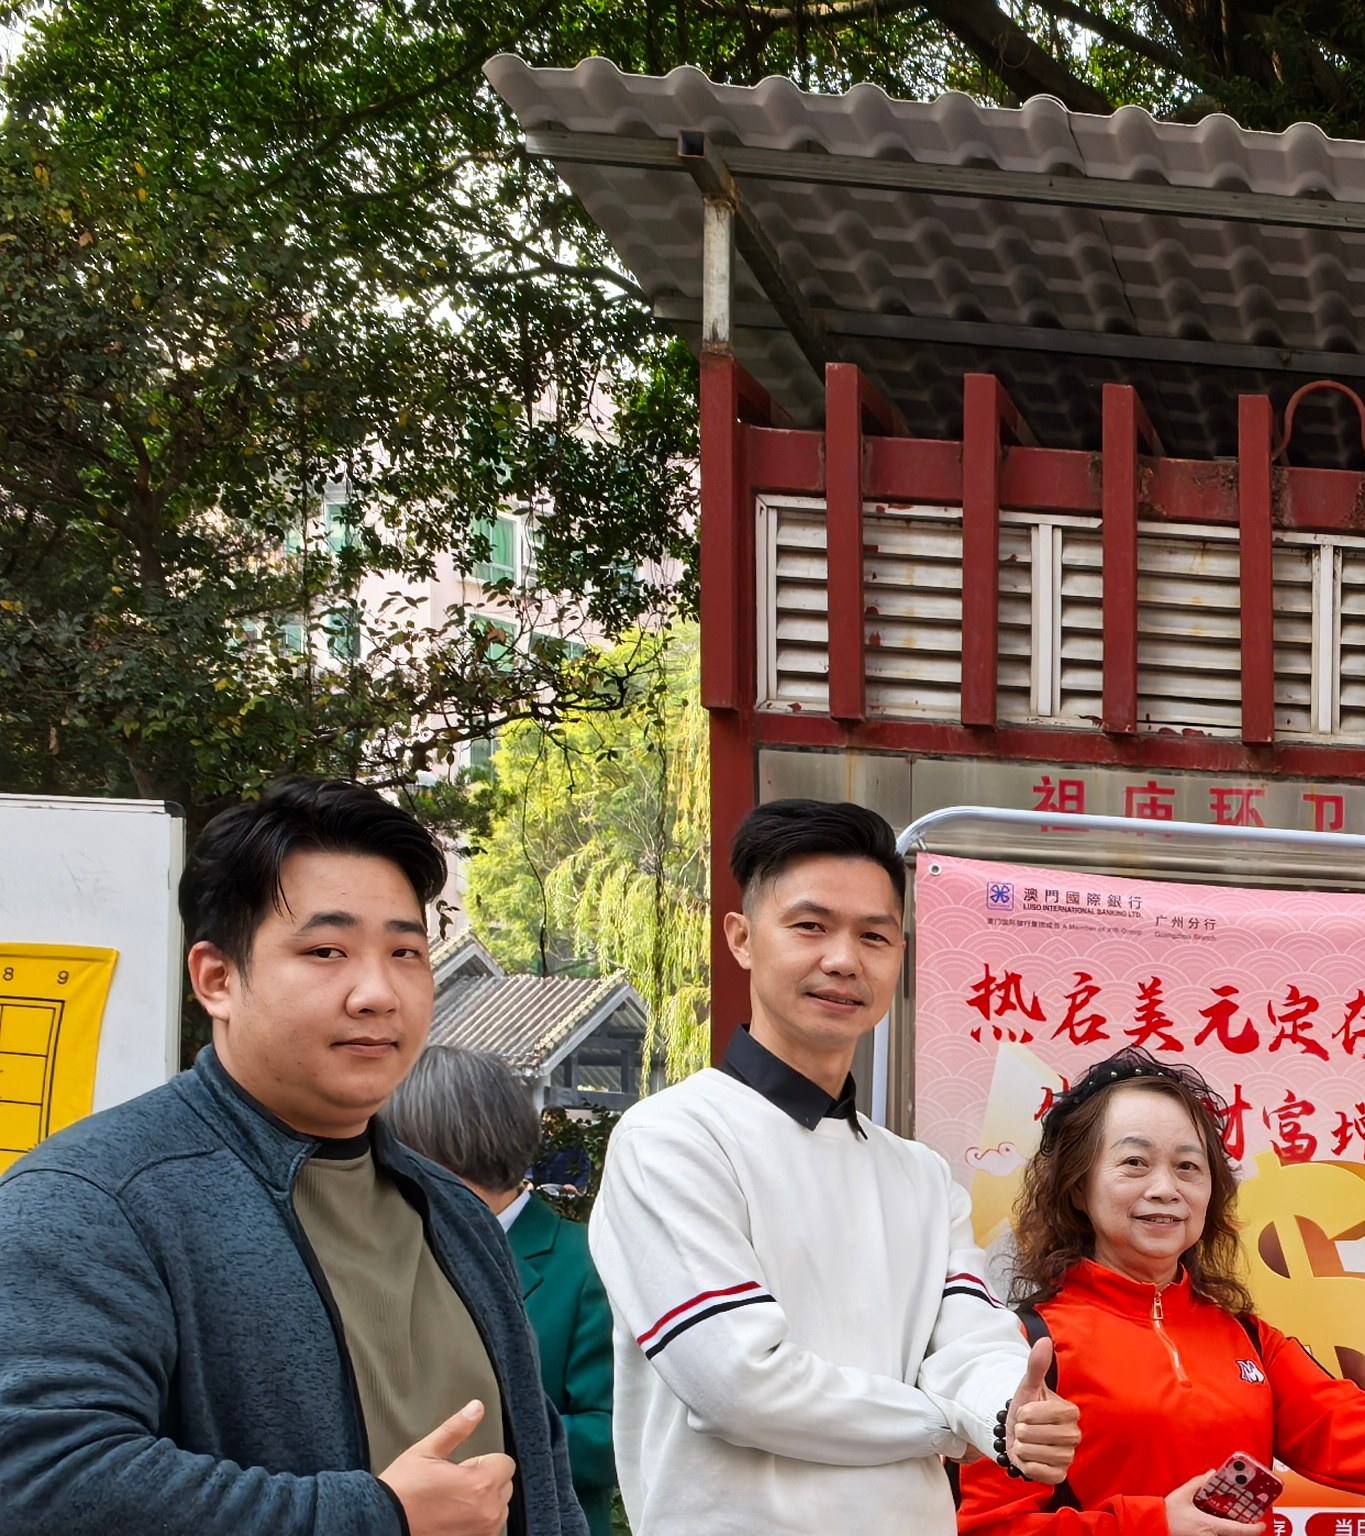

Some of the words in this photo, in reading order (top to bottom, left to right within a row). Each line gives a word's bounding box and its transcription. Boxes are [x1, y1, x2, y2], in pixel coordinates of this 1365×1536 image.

[1023, 888, 1142, 909] 澳門國際銀行
[1023, 903, 1041, 911] LUSO
[1042, 905, 1095, 915] INTERNATIONAL
[1097, 908, 1126, 918] BANKING
[1155, 915, 1216, 931] 广州分行
[2, 967, 14, 981] 8
[57, 970, 69, 985] 9
